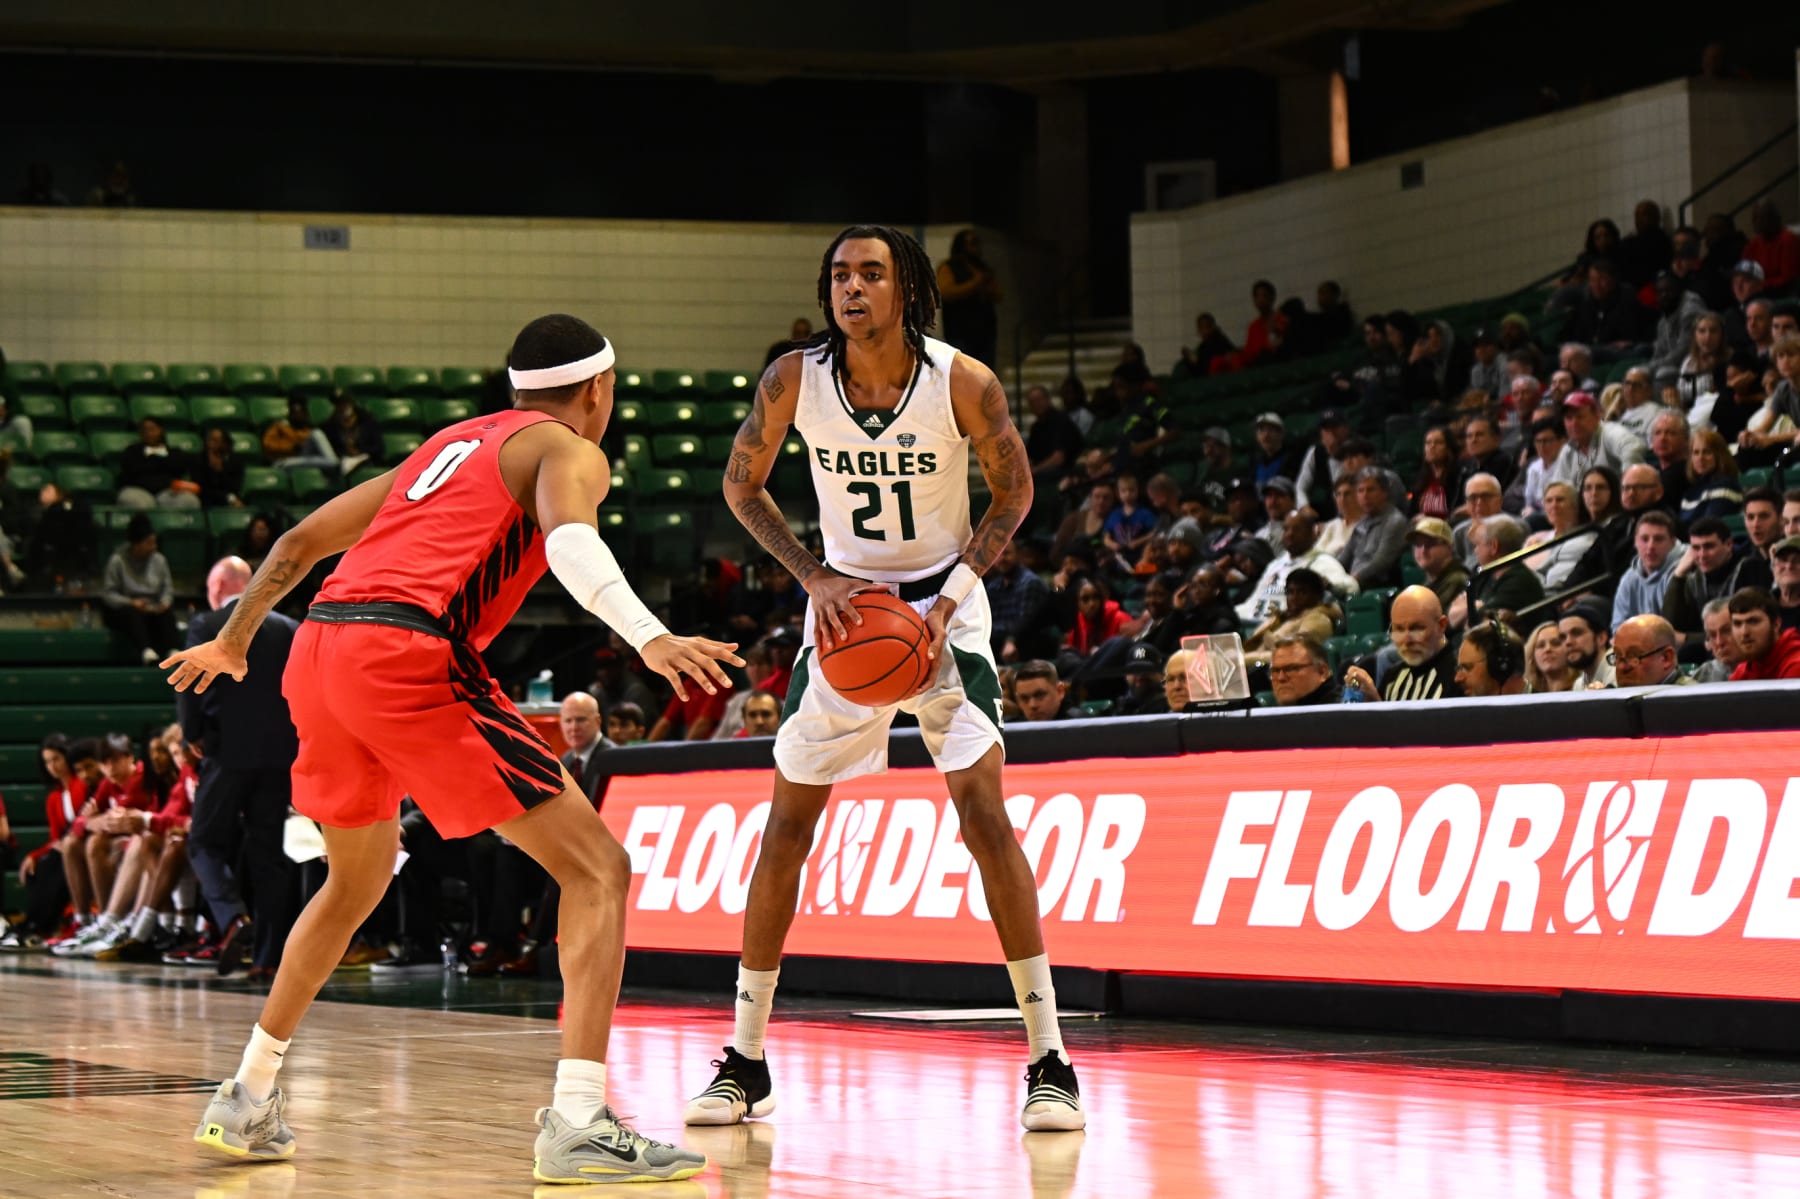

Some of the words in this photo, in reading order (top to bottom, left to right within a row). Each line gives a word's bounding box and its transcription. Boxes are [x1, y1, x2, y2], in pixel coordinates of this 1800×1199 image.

[405, 439, 483, 502] 0
[815, 447, 937, 476] EAGLES
[846, 480, 917, 542] 21
[1191, 782, 1566, 933] FLOOR
[1545, 779, 1668, 936] &
